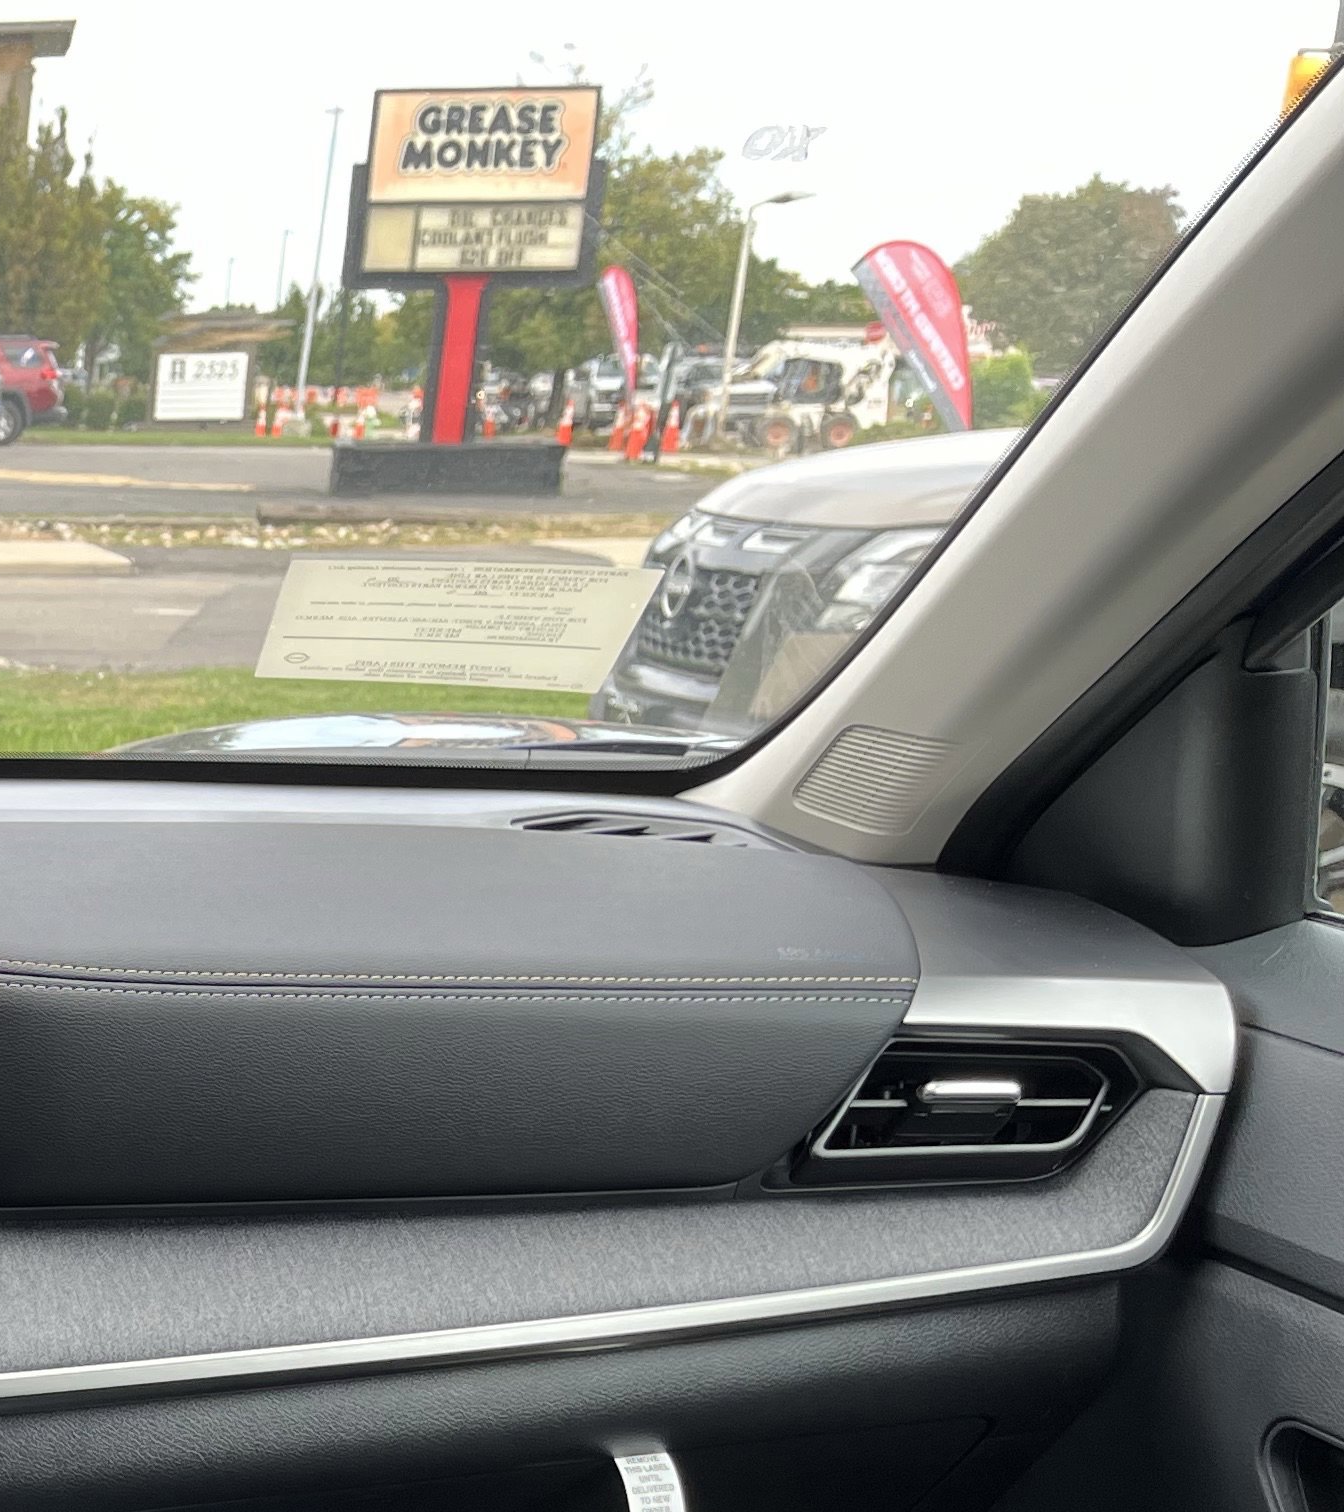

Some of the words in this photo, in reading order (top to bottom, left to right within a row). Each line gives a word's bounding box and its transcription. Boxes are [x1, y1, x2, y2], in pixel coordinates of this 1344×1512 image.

[418, 104, 559, 135] GREASE
[402, 138, 564, 170] MONKEY
[626, 1455, 659, 1464] REMOVE
[624, 1465, 643, 1474] THIS
[644, 1463, 670, 1473] LABEL
[632, 1484, 674, 1494] DELIVERED
[640, 1496, 651, 1505] TO
[653, 1495, 670, 1503] NEW
